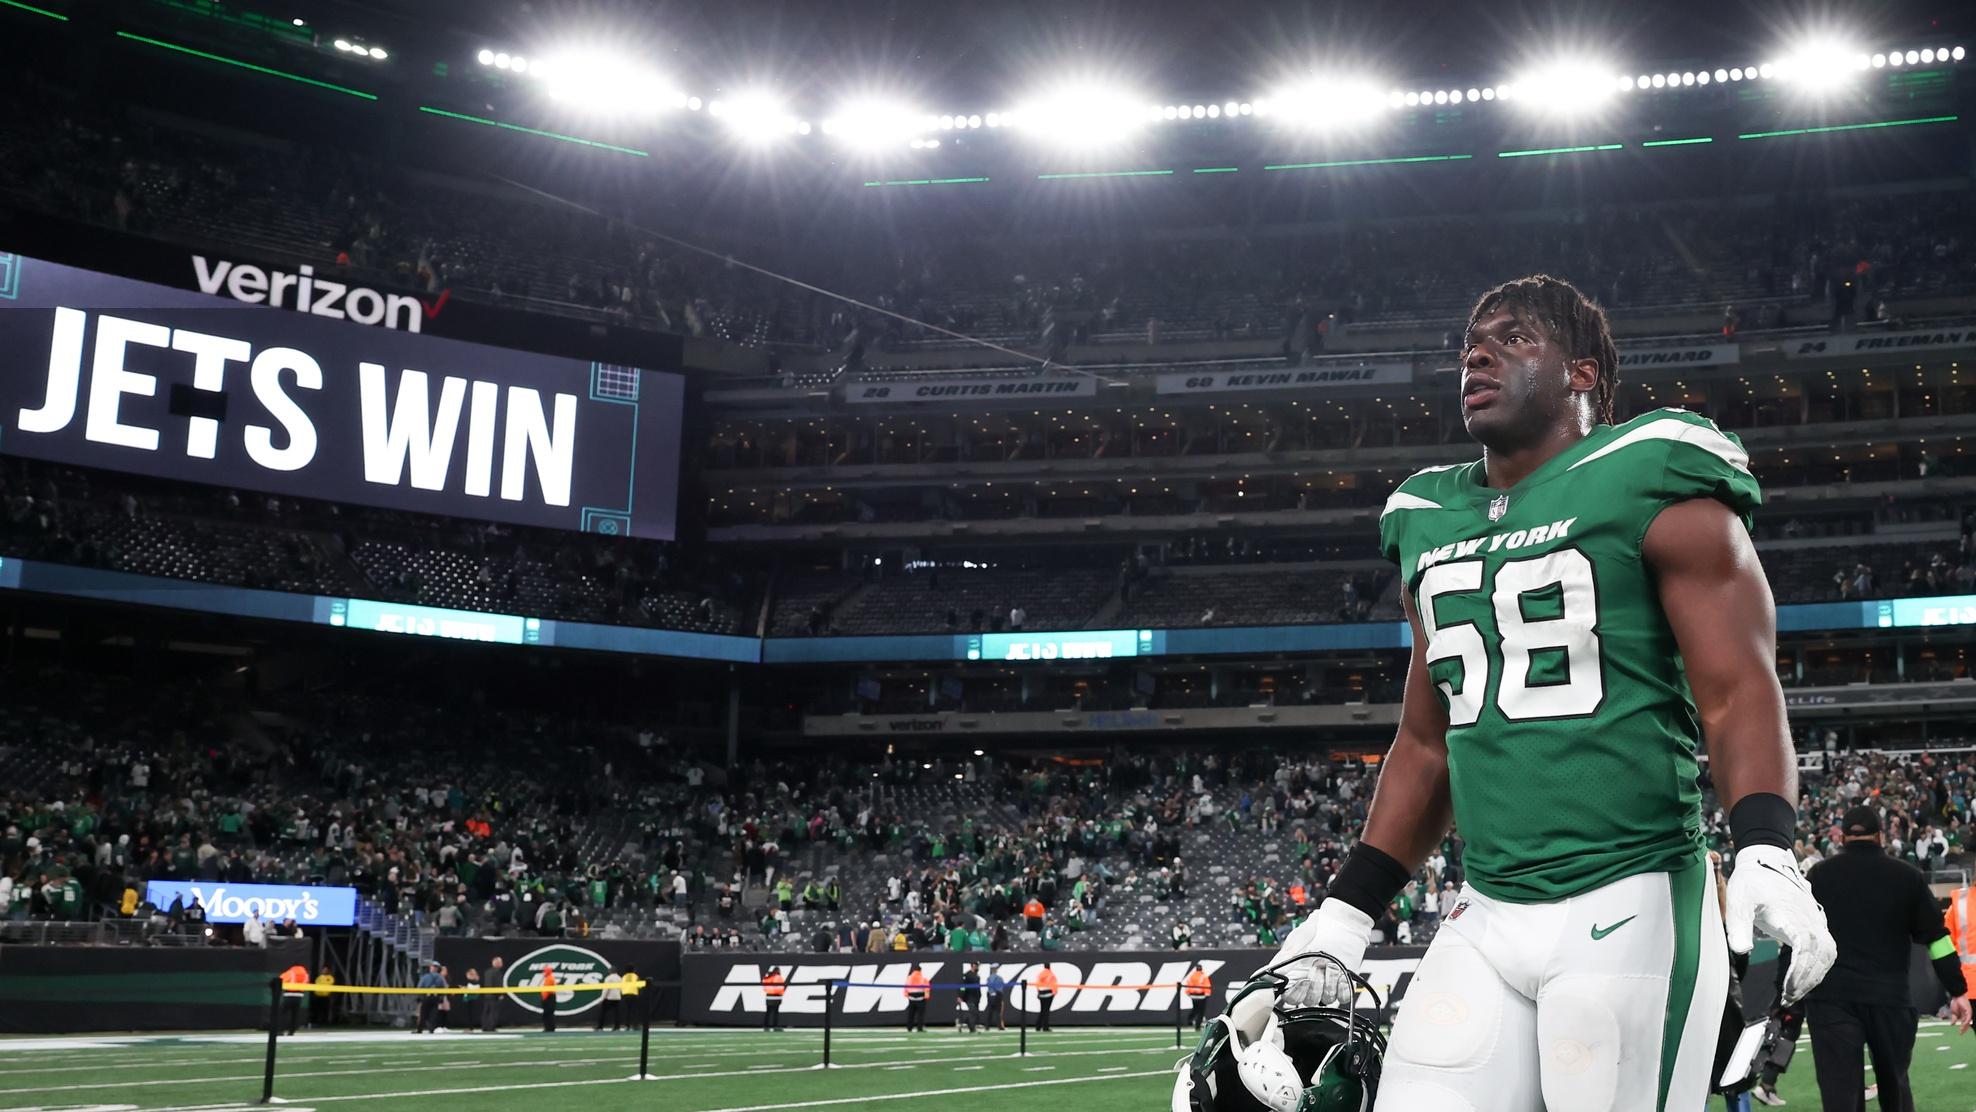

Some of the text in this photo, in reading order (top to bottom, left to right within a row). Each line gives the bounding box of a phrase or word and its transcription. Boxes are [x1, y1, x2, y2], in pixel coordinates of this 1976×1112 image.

[191, 254, 423, 334] verizon
[1854, 332, 1962, 350] FREEMAN
[915, 383, 993, 397] CURTIS
[995, 382, 1079, 395] MARTIN
[1227, 373, 1292, 387] KEVIN
[1296, 369, 1376, 384] MAWAE
[18, 305, 578, 507] JETS WIN
[1417, 517, 1578, 571] NEW YORK
[1417, 545, 1606, 728] 58
[560, 962, 595, 971] YORK
[709, 961, 945, 1013] NEW
